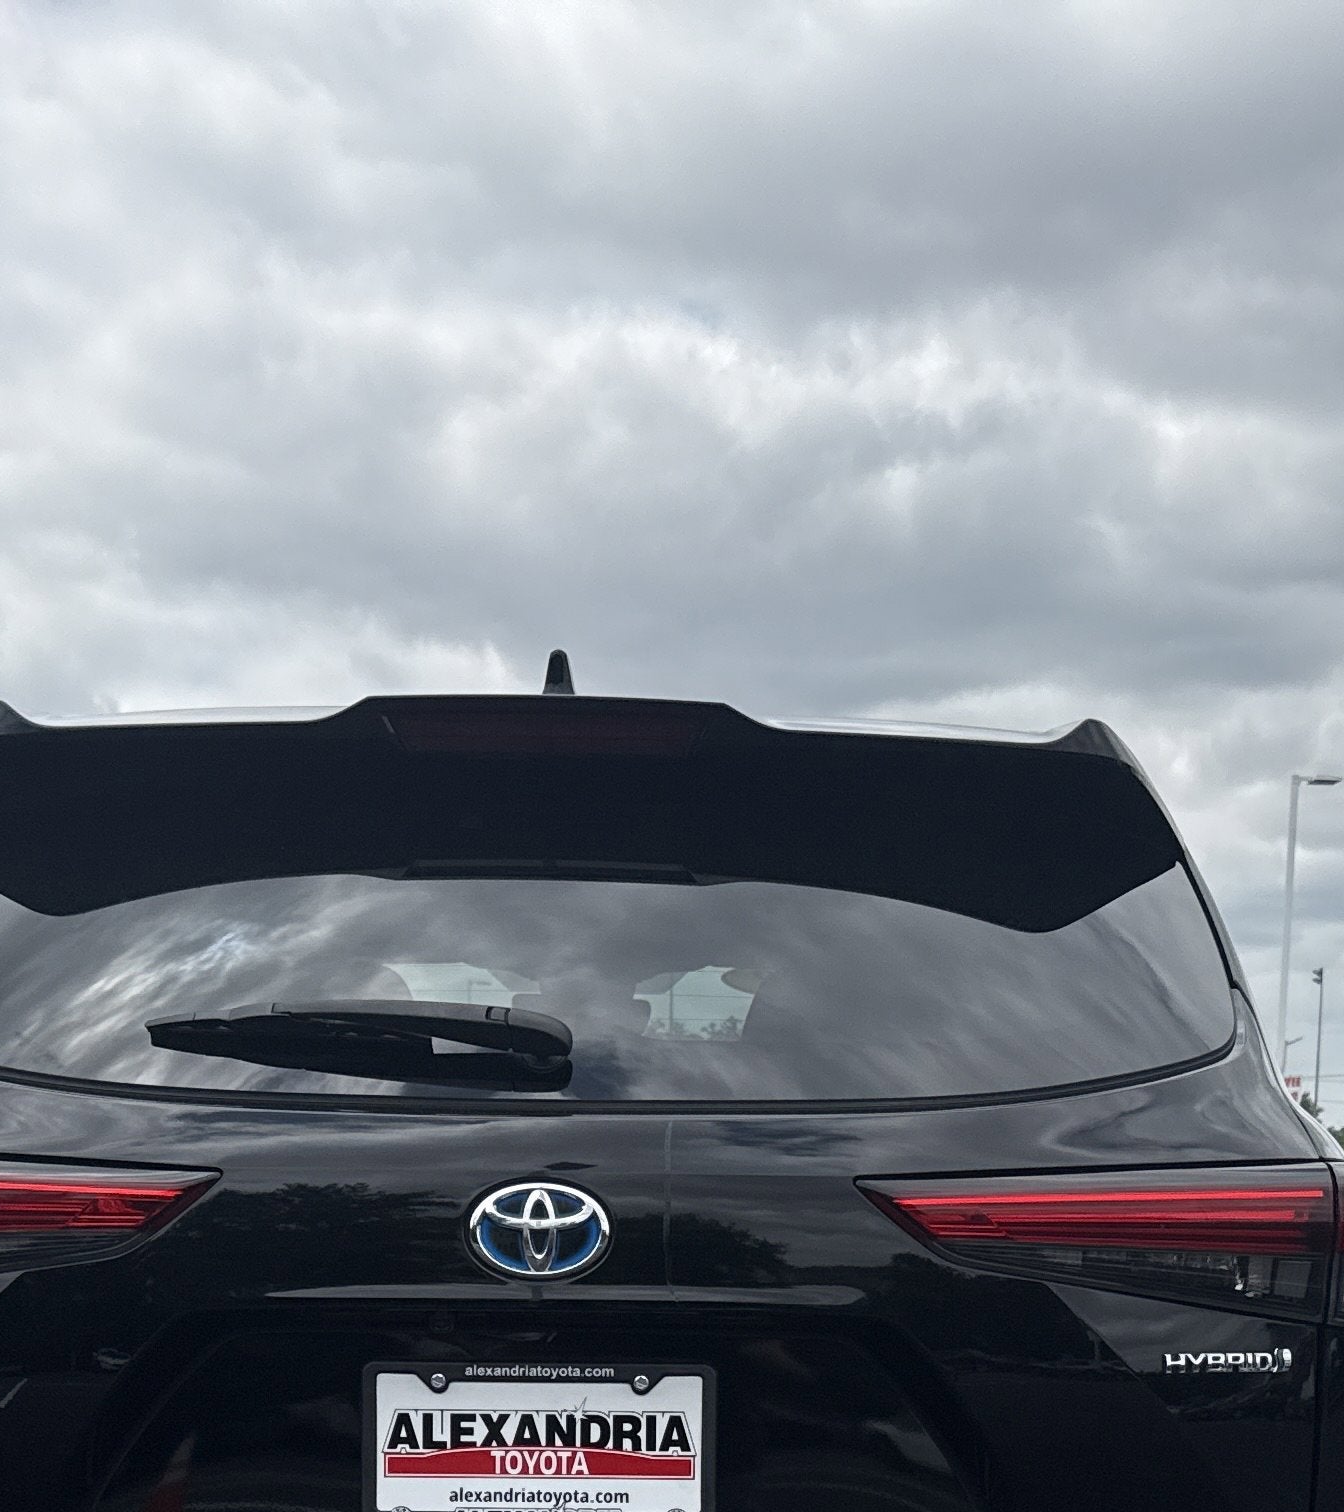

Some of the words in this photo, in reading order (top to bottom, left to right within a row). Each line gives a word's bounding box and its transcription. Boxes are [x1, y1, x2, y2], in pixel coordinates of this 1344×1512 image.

[464, 1364, 615, 1379] alexandriatoyota.com
[1164, 1353, 1273, 1373] HYBRID
[386, 1411, 692, 1453] ALEXANDRIA
[490, 1450, 590, 1475] TOYOTA
[449, 1487, 630, 1507] alexandriatoyota.com
